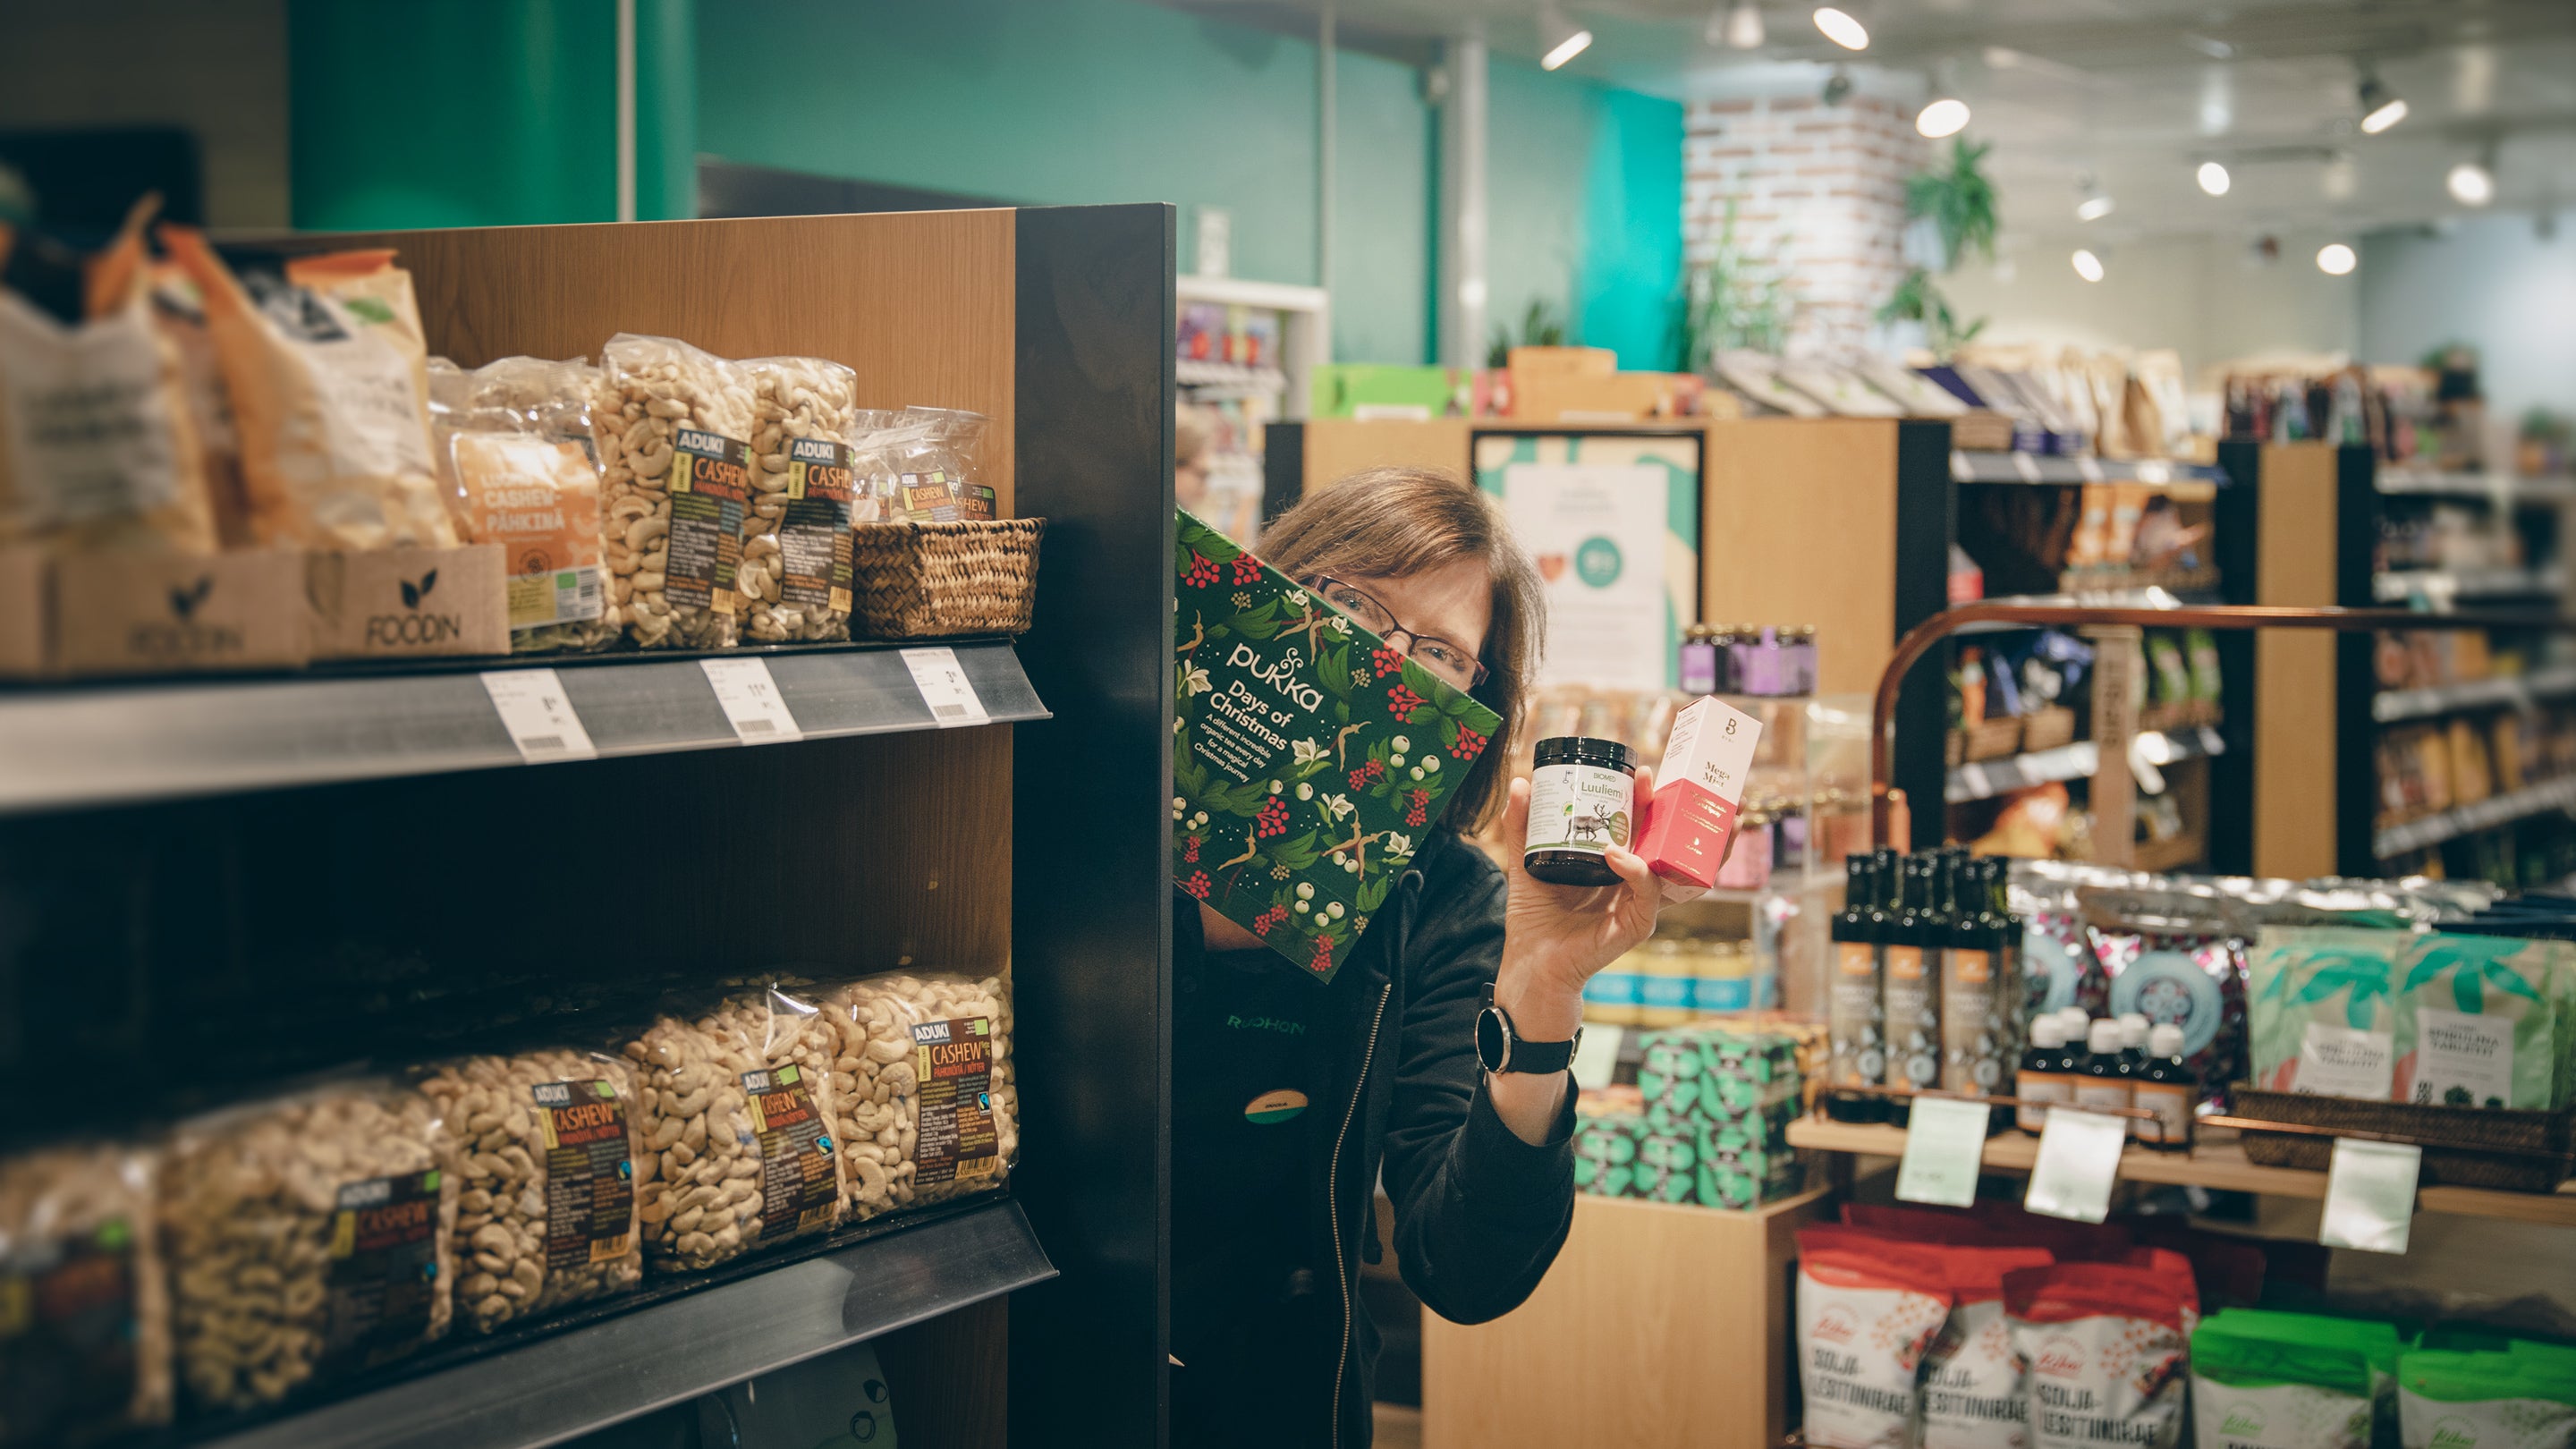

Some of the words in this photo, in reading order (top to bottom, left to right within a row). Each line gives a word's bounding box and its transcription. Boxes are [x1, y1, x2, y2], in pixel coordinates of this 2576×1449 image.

[678, 431, 725, 454] ADUKI
[793, 441, 835, 460] ADUKI
[911, 487, 945, 502] CASHEW
[486, 508, 565, 532] PÄHKINÄ
[366, 613, 462, 646] FOODIN
[1228, 680, 1269, 715] Days
[1270, 711, 1294, 728] of
[1209, 692, 1288, 750] Christmas
[1199, 723, 1225, 743] organic
[1224, 738, 1235, 750] tea
[1234, 744, 1254, 761] every
[1252, 756, 1267, 769] day
[1206, 713, 1214, 722] A
[1212, 717, 1241, 739] different
[1240, 734, 1272, 759] incredible
[1194, 742, 1226, 767] Christmas
[1224, 763, 1250, 784] journey
[1207, 738, 1218, 749] for
[1223, 749, 1250, 768] magical
[1593, 772, 1616, 783] BIOMED
[1703, 772, 1724, 788] Mist
[1705, 761, 1731, 781] Mega
[1580, 782, 1623, 800] Luuliemi
[914, 1023, 950, 1041] ADUKI
[932, 1042, 982, 1065] CASHEW
[552, 1102, 614, 1131] CASHEW
